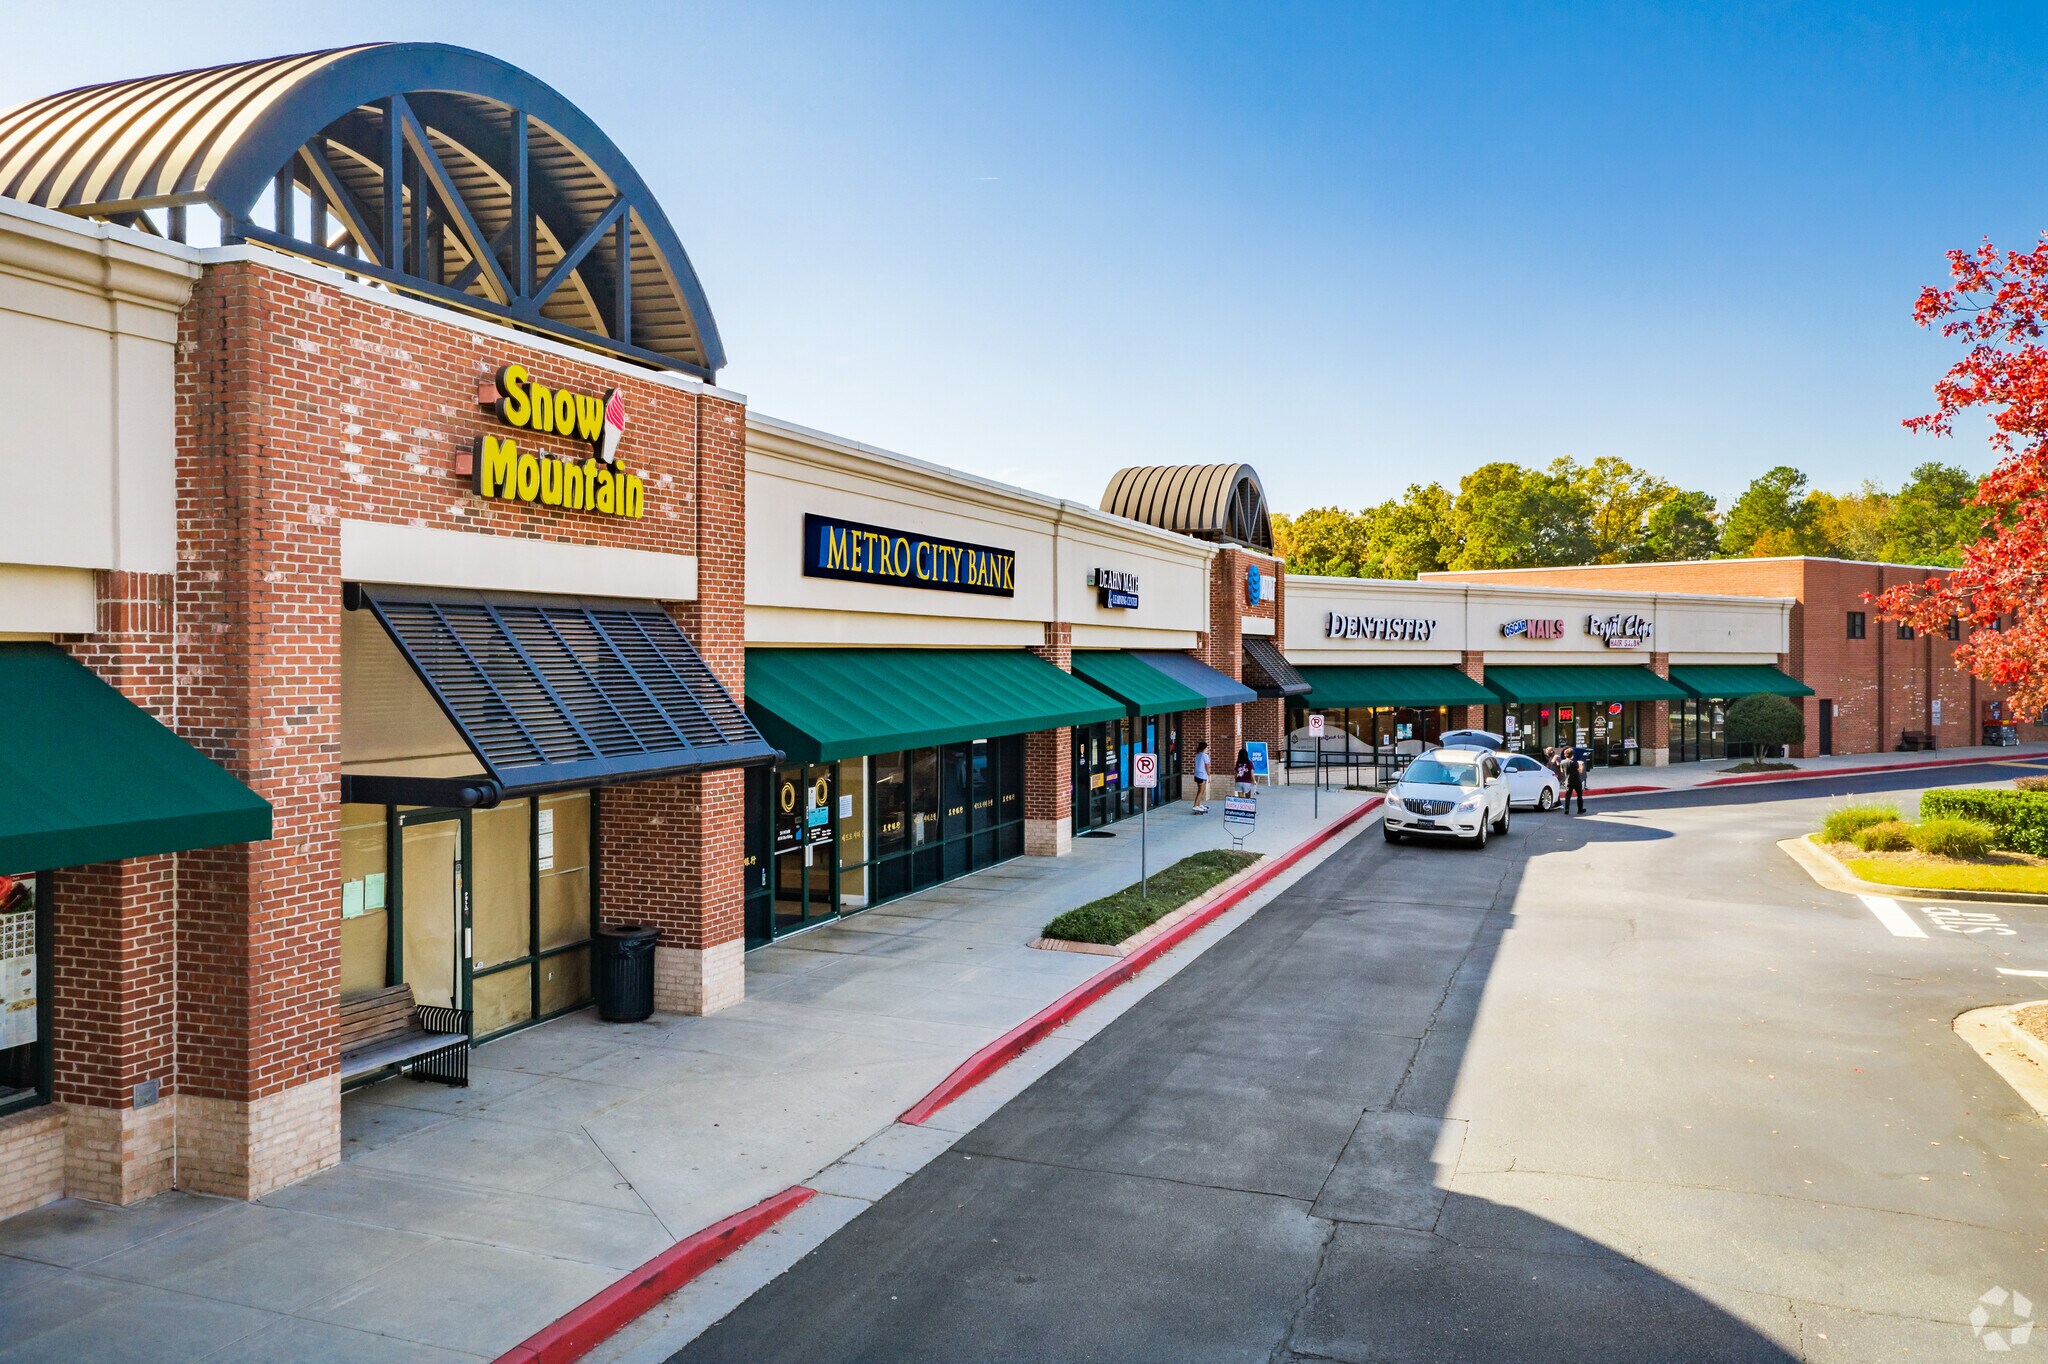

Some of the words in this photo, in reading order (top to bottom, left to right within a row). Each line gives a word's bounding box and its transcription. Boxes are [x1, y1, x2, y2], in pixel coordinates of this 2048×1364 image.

[502, 364, 604, 442] Snow
[480, 435, 644, 519] Mountain
[826, 525, 911, 578] METRO
[915, 541, 964, 584] CITY
[967, 549, 1015, 591] BANK
[1123, 573, 1139, 593] MATH
[1329, 611, 1438, 641] DENTISTRY
[1505, 619, 1527, 637] OSCAR
[1526, 619, 1565, 639] NAILS
[1590, 614, 1622, 641] Royal
[1624, 614, 1653, 641] Clips
[1610, 639, 1623, 647] HAIR
[1921, 906, 2017, 936] STOP
